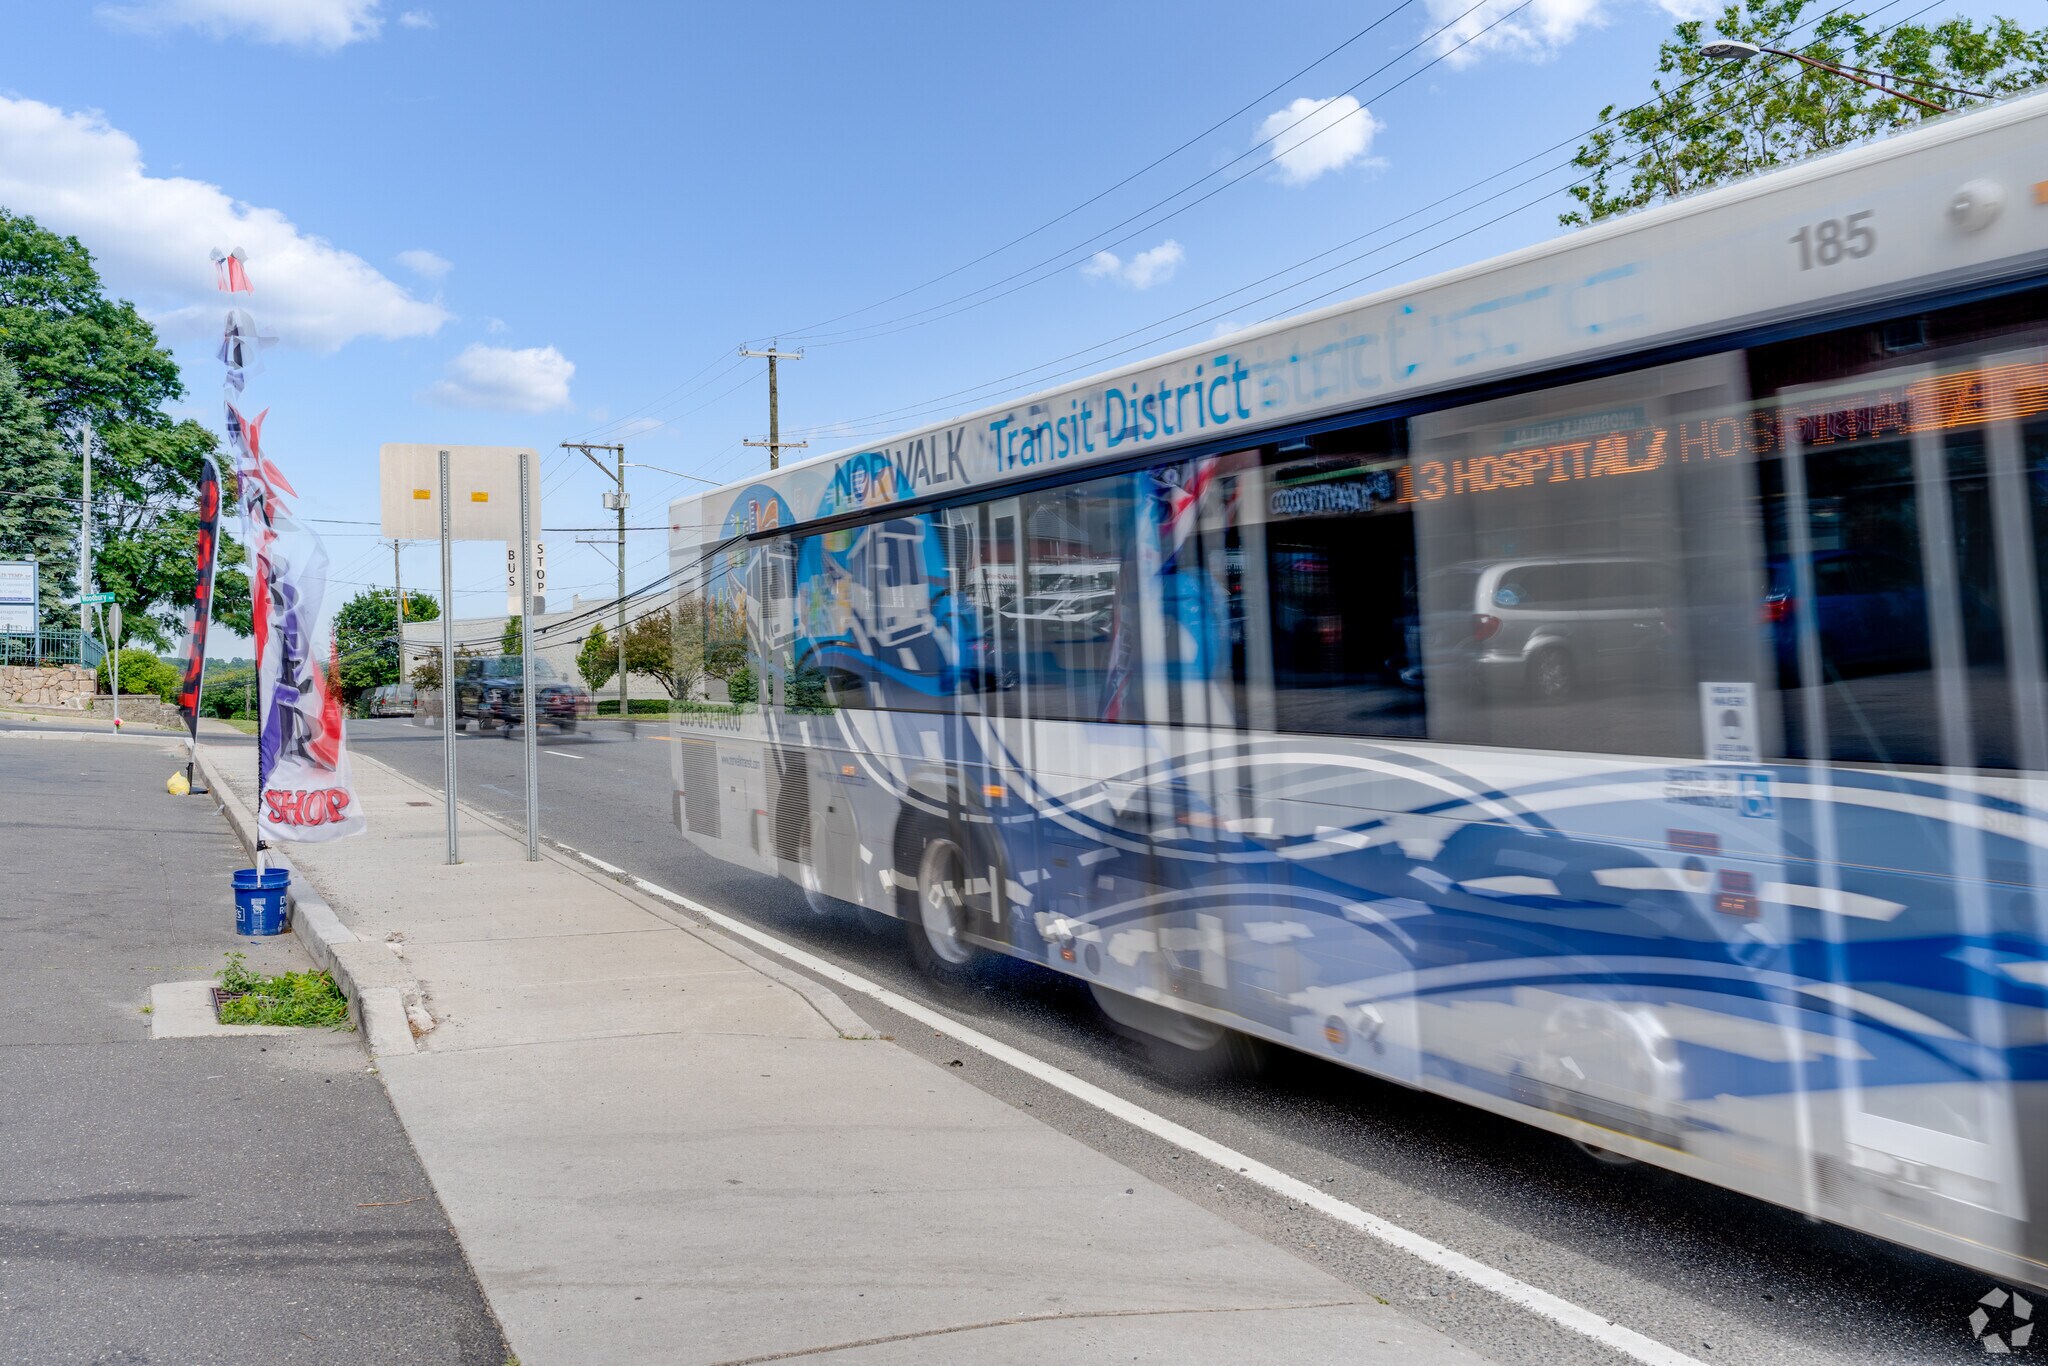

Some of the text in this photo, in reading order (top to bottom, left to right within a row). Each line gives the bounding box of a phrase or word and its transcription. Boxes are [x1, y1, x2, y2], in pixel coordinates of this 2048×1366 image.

[1790, 210, 1878, 271] 185
[834, 360, 1251, 506] NORWALK Transit District
[1397, 460, 1448, 503] 13
[1452, 430, 1662, 494] HOSPITAL
[536, 543, 546, 592] STOP
[82, 594, 107, 603] Woodbury
[264, 788, 350, 827] SHOP
